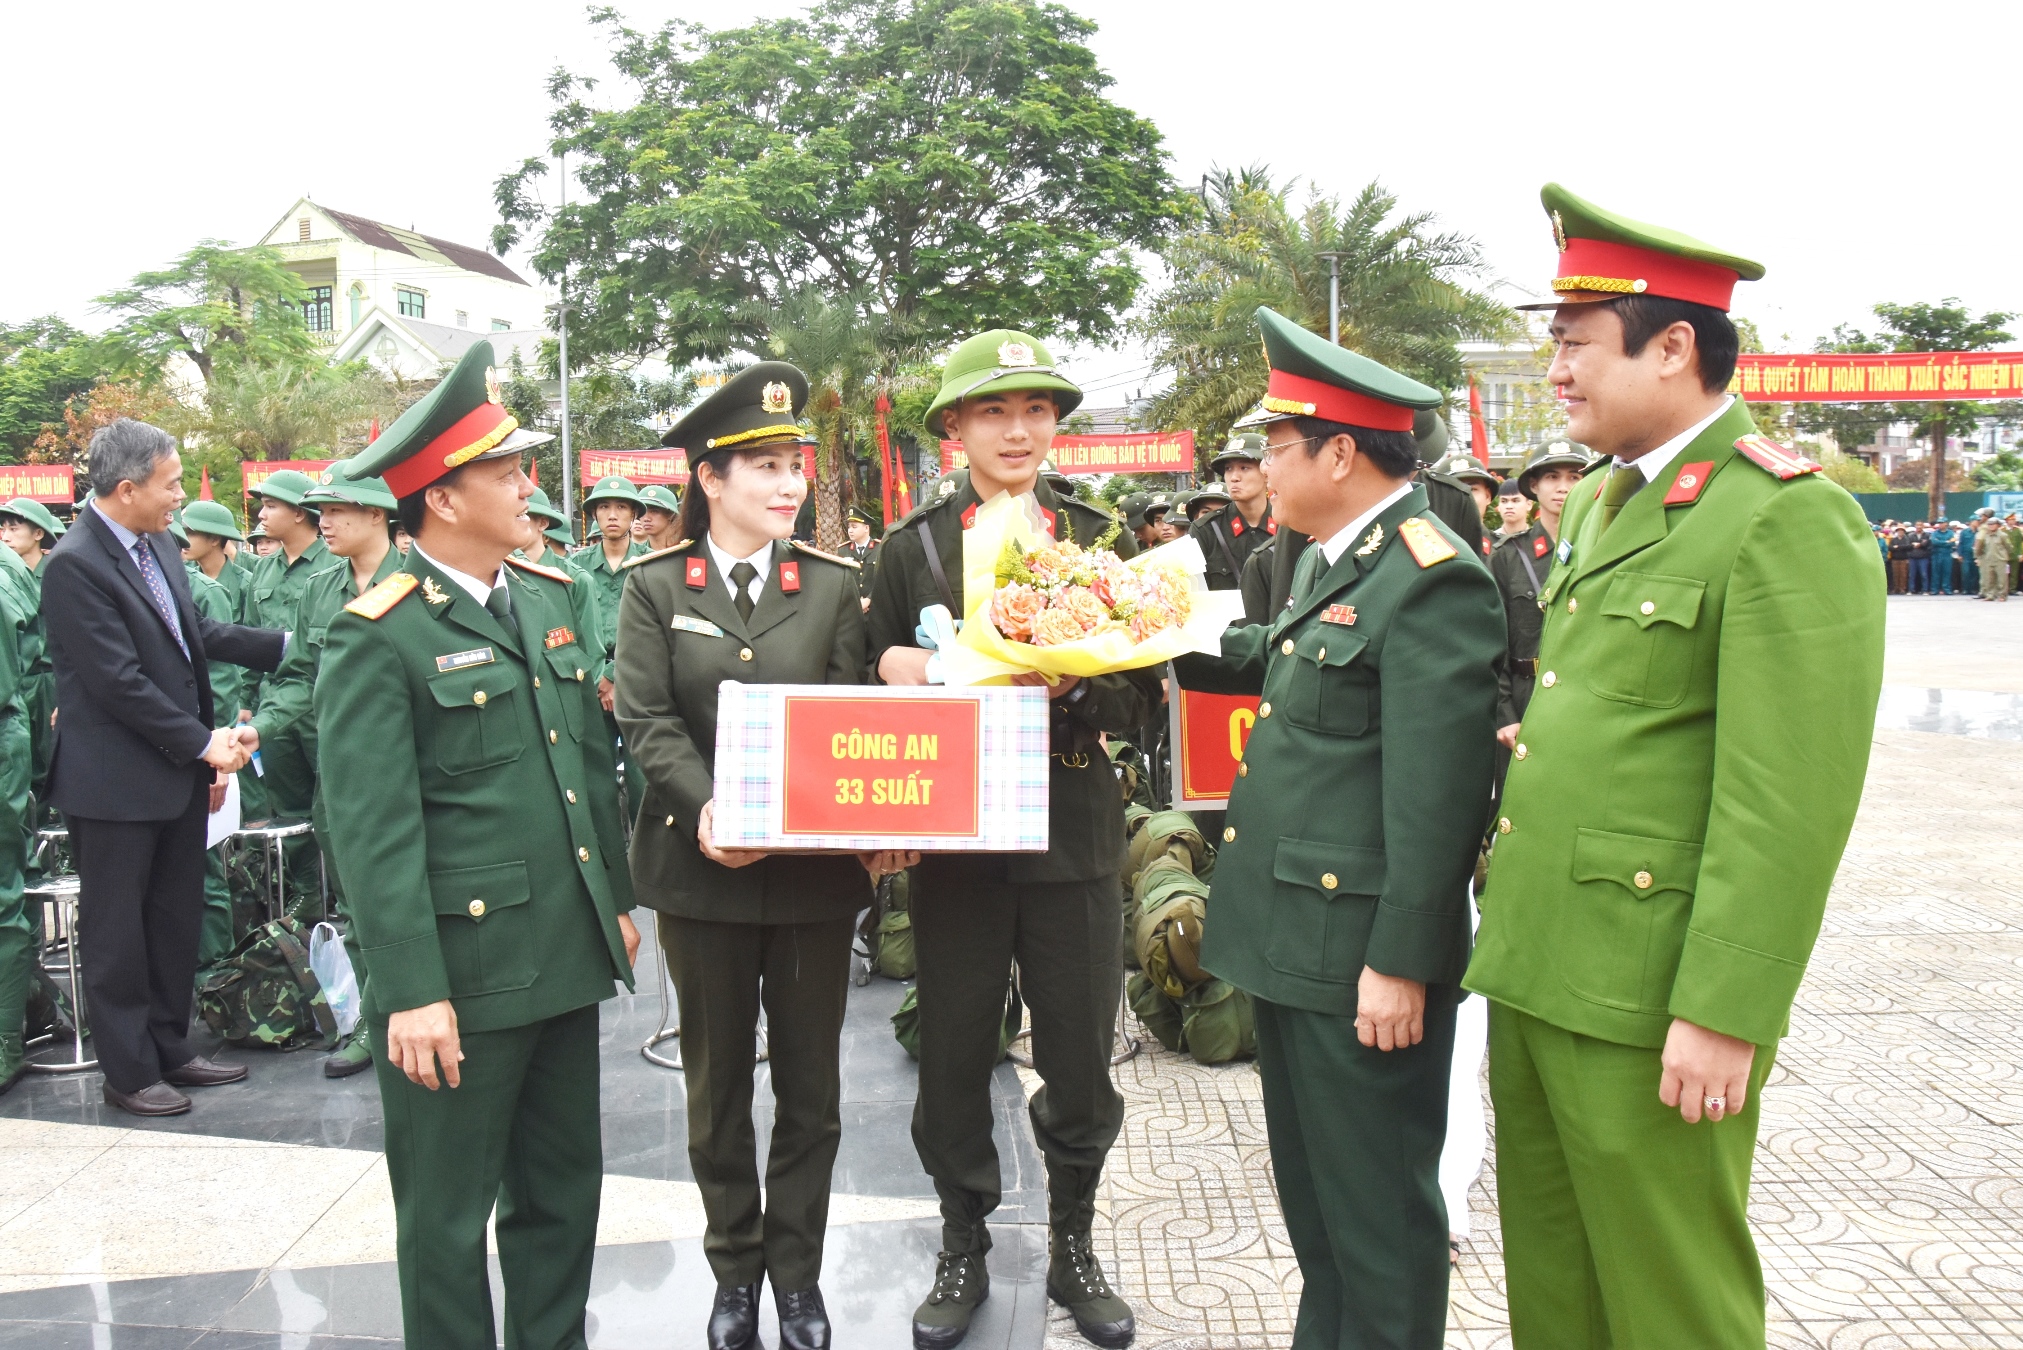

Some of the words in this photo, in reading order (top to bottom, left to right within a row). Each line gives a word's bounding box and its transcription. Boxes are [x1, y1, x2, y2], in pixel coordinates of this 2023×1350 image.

[1743, 361, 1760, 392] HÀ
[1763, 358, 1801, 395] QUYẾT
[1803, 361, 1829, 392] TÂM
[1831, 361, 1865, 392] HOÀN
[1867, 361, 1907, 391] THÀNH
[1909, 356, 1941, 391] XUẤT
[1942, 355, 1968, 390] SẮC
[1969, 358, 2010, 395] NHIỆM
[637, 457, 650, 479] VIỆT
[651, 460, 665, 476] NAM
[1060, 443, 1072, 466] HÁI
[1074, 443, 1089, 466] LÊN
[1090, 442, 1117, 465] ĐƯỜNG
[1118, 439, 1135, 464] BẢO
[1136, 441, 1147, 467] VỆ
[1147, 437, 1159, 463] TỔ
[1160, 438, 1182, 464] QUỐC
[16, 470, 33, 496] CỦA
[32, 473, 53, 496] TOÀN
[53, 473, 70, 495] DÂN
[831, 727, 897, 760] CÔNG
[903, 734, 938, 761] AN
[835, 778, 865, 805] 33
[871, 769, 934, 805] SUẤT
